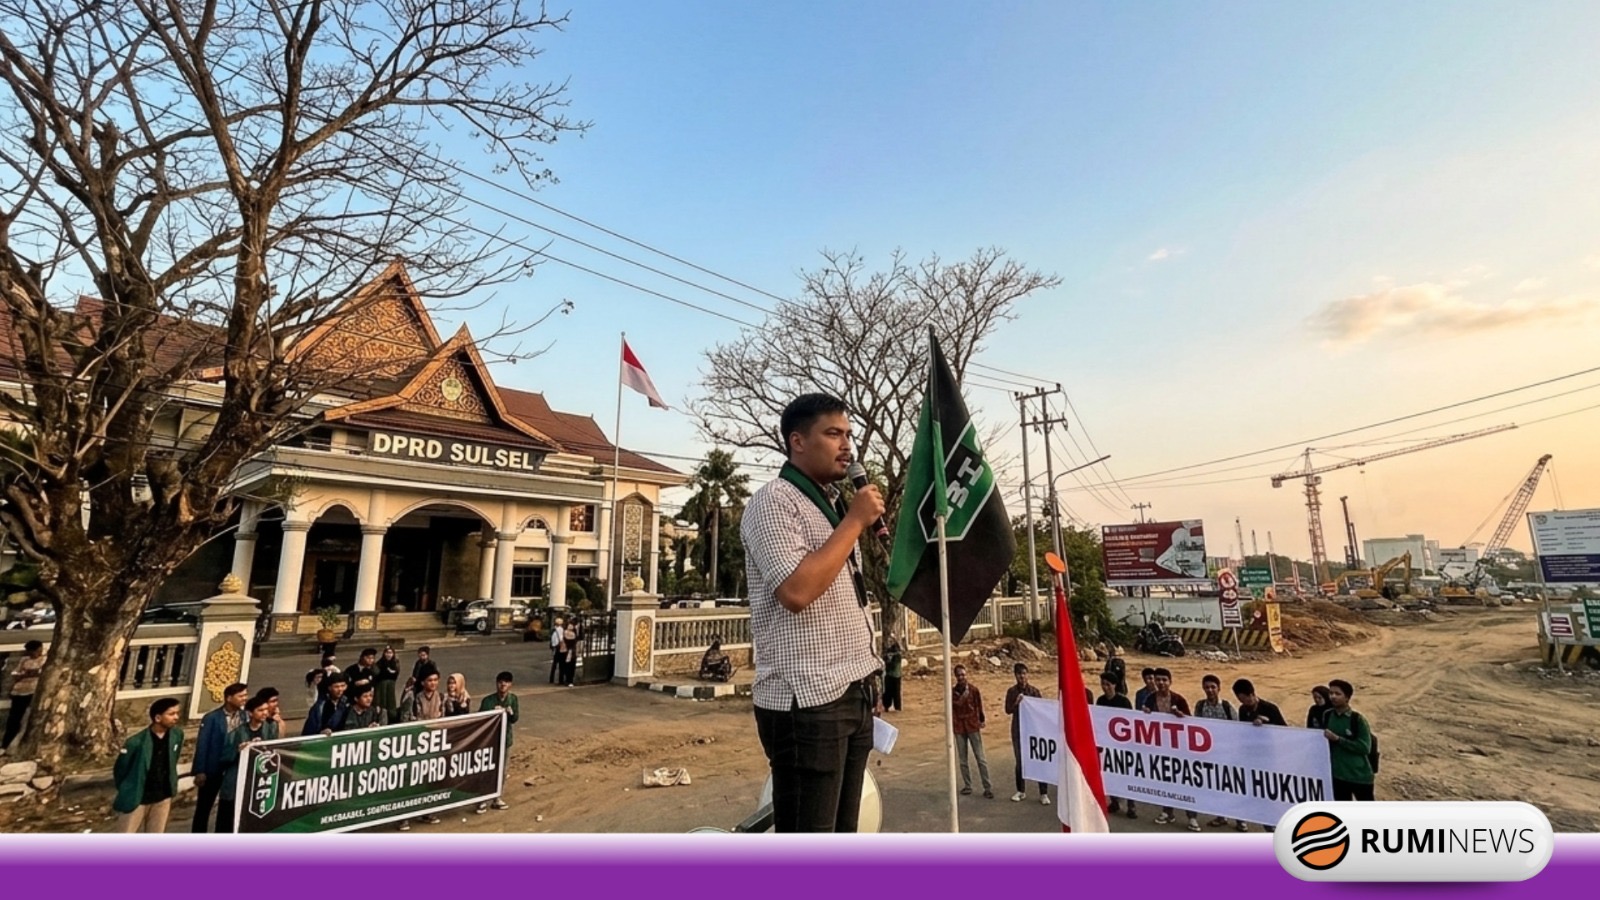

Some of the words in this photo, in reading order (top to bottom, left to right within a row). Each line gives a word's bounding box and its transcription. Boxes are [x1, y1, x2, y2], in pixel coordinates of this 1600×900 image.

[373, 433, 443, 459] DPRD
[450, 443, 534, 470] SULSEL
[331, 741, 371, 769] HMI
[377, 728, 452, 760] SULSEL
[1108, 716, 1213, 753] GMTD
[281, 772, 354, 811] KEMBALI
[357, 763, 407, 794] SOROT
[410, 757, 447, 787] DPRD
[449, 747, 496, 779] SULSEL
[1149, 753, 1247, 795] KEPASTIAN
[1251, 769, 1325, 803] HUKUM
